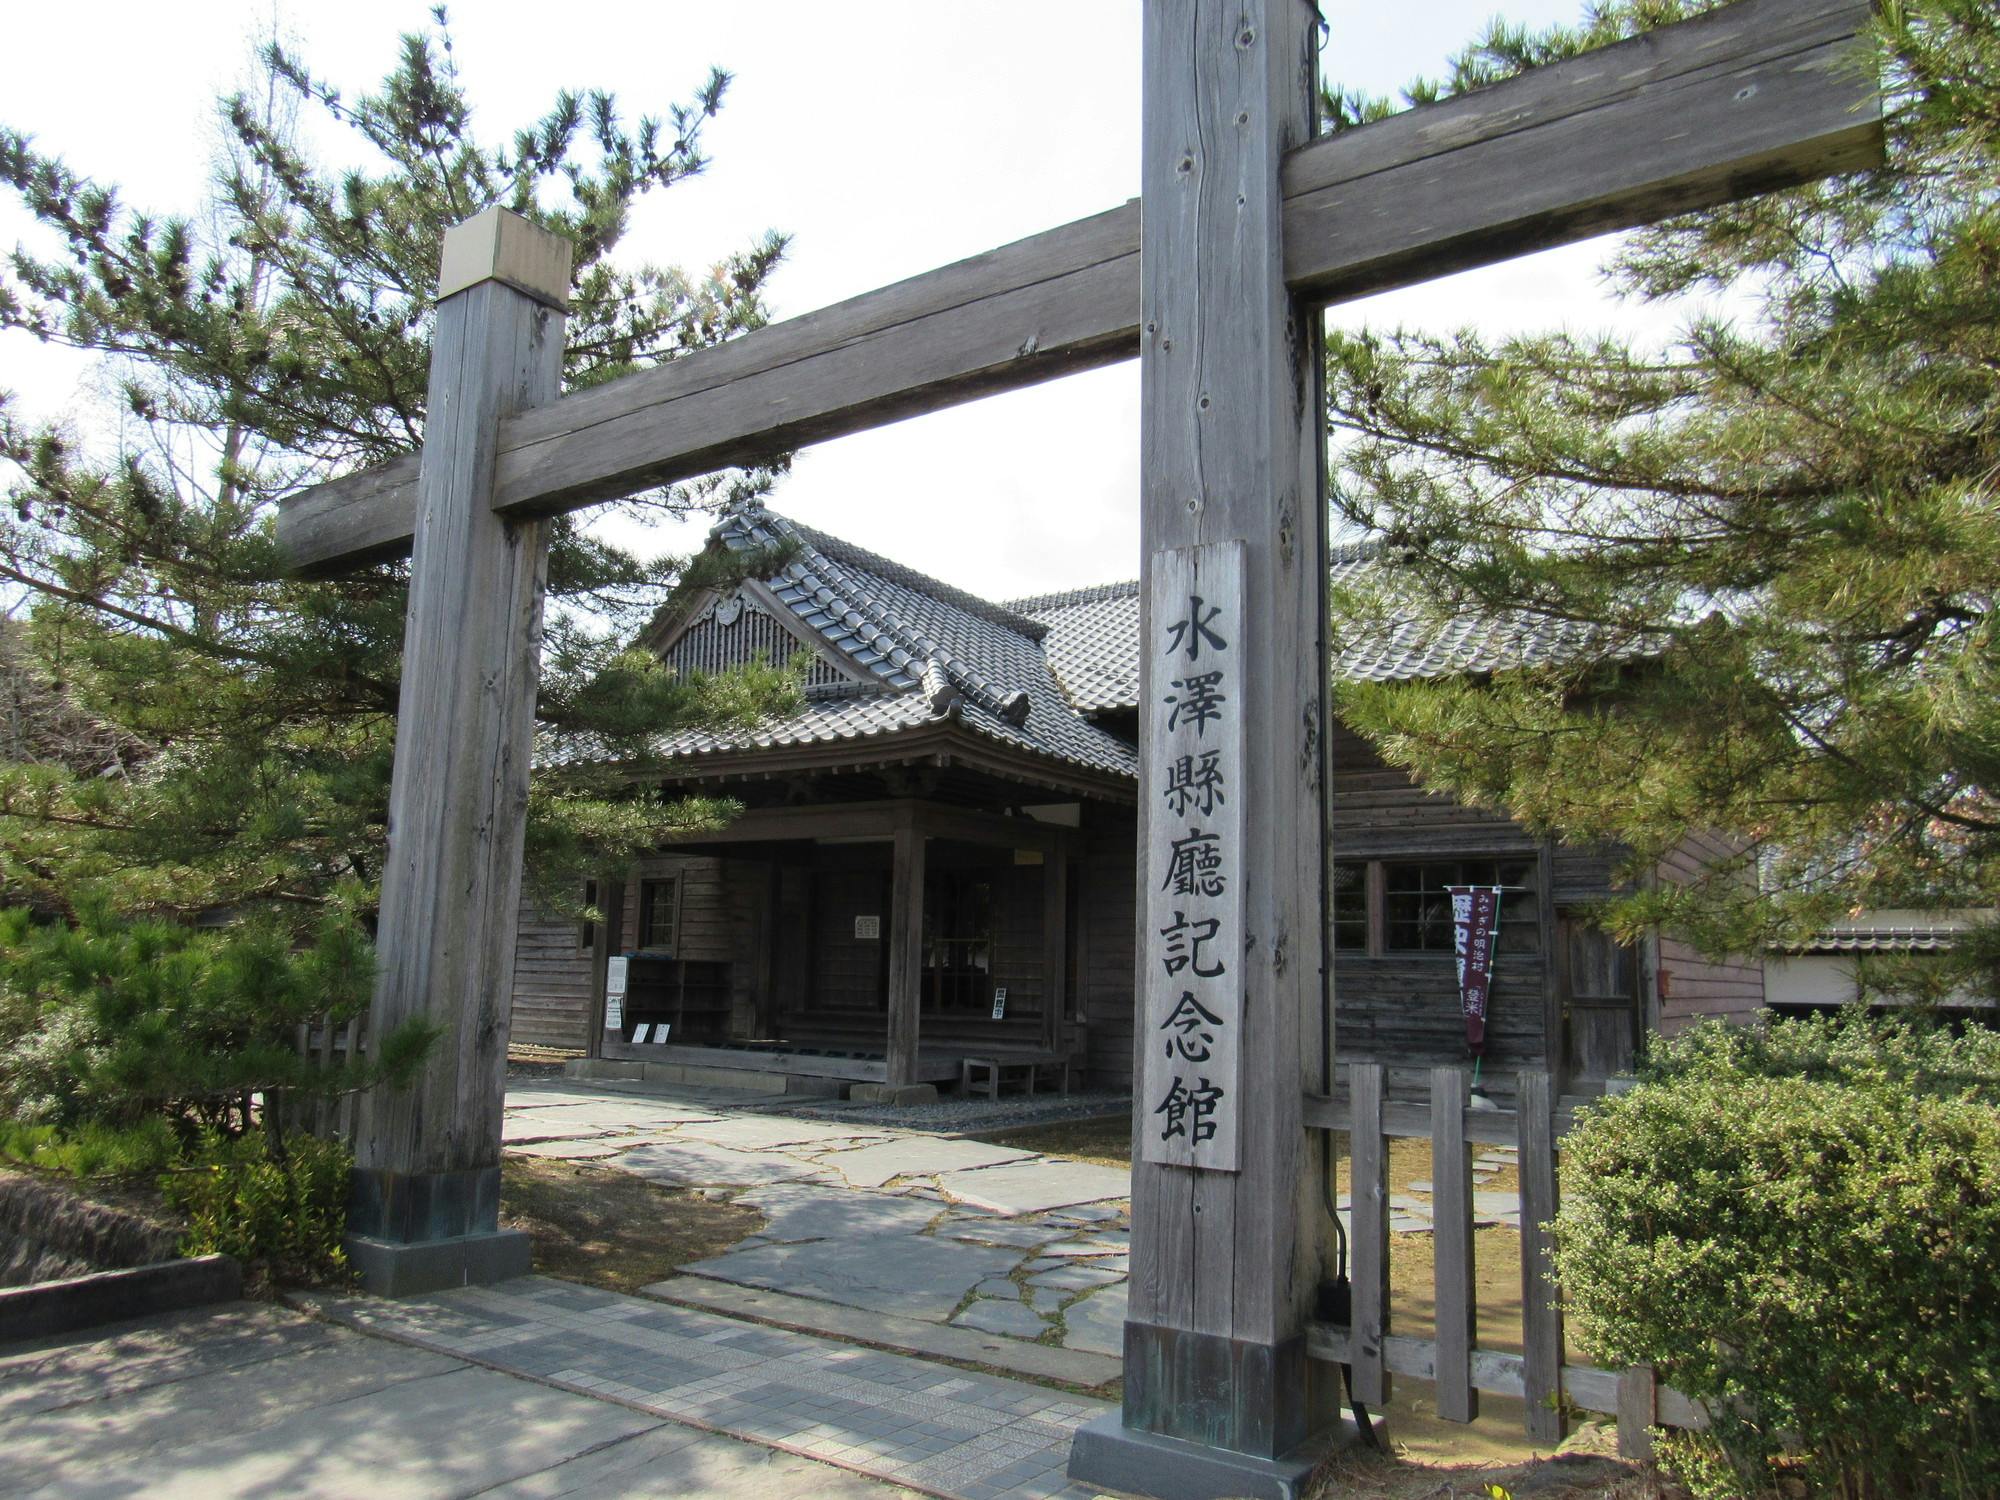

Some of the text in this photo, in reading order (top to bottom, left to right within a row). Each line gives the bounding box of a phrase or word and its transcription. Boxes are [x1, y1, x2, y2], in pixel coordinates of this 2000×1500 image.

[1153, 594, 1228, 1144] 水澤縣廳記念館
[1471, 894, 1489, 972] みやぎの明治村
